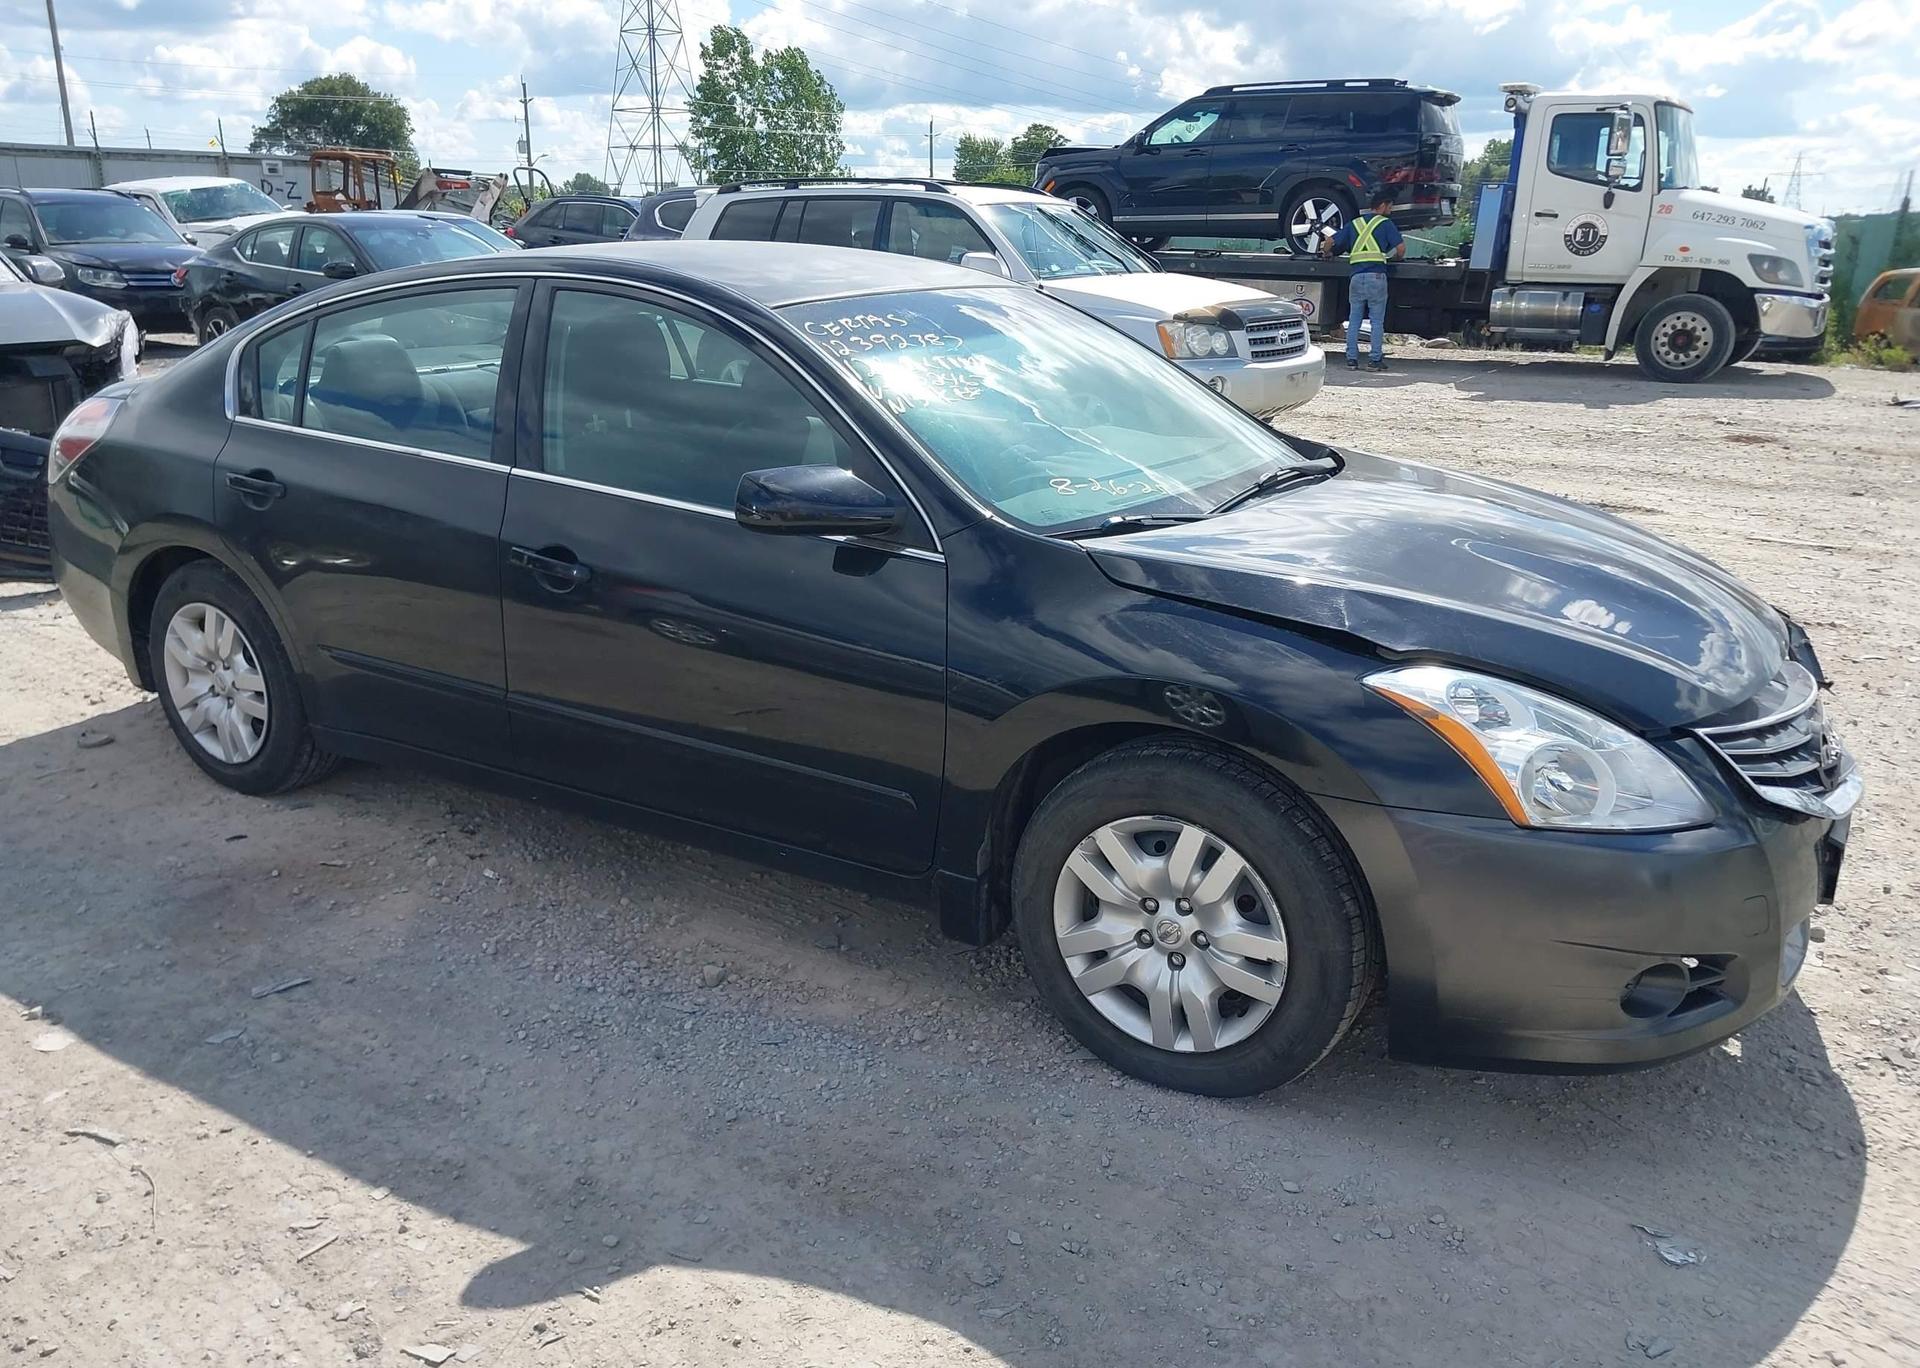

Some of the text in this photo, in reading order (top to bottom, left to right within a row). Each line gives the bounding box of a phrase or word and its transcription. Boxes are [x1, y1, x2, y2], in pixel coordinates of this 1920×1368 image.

[1656, 204, 1674, 215] 26
[1692, 210, 1767, 231] 647-293 7062
